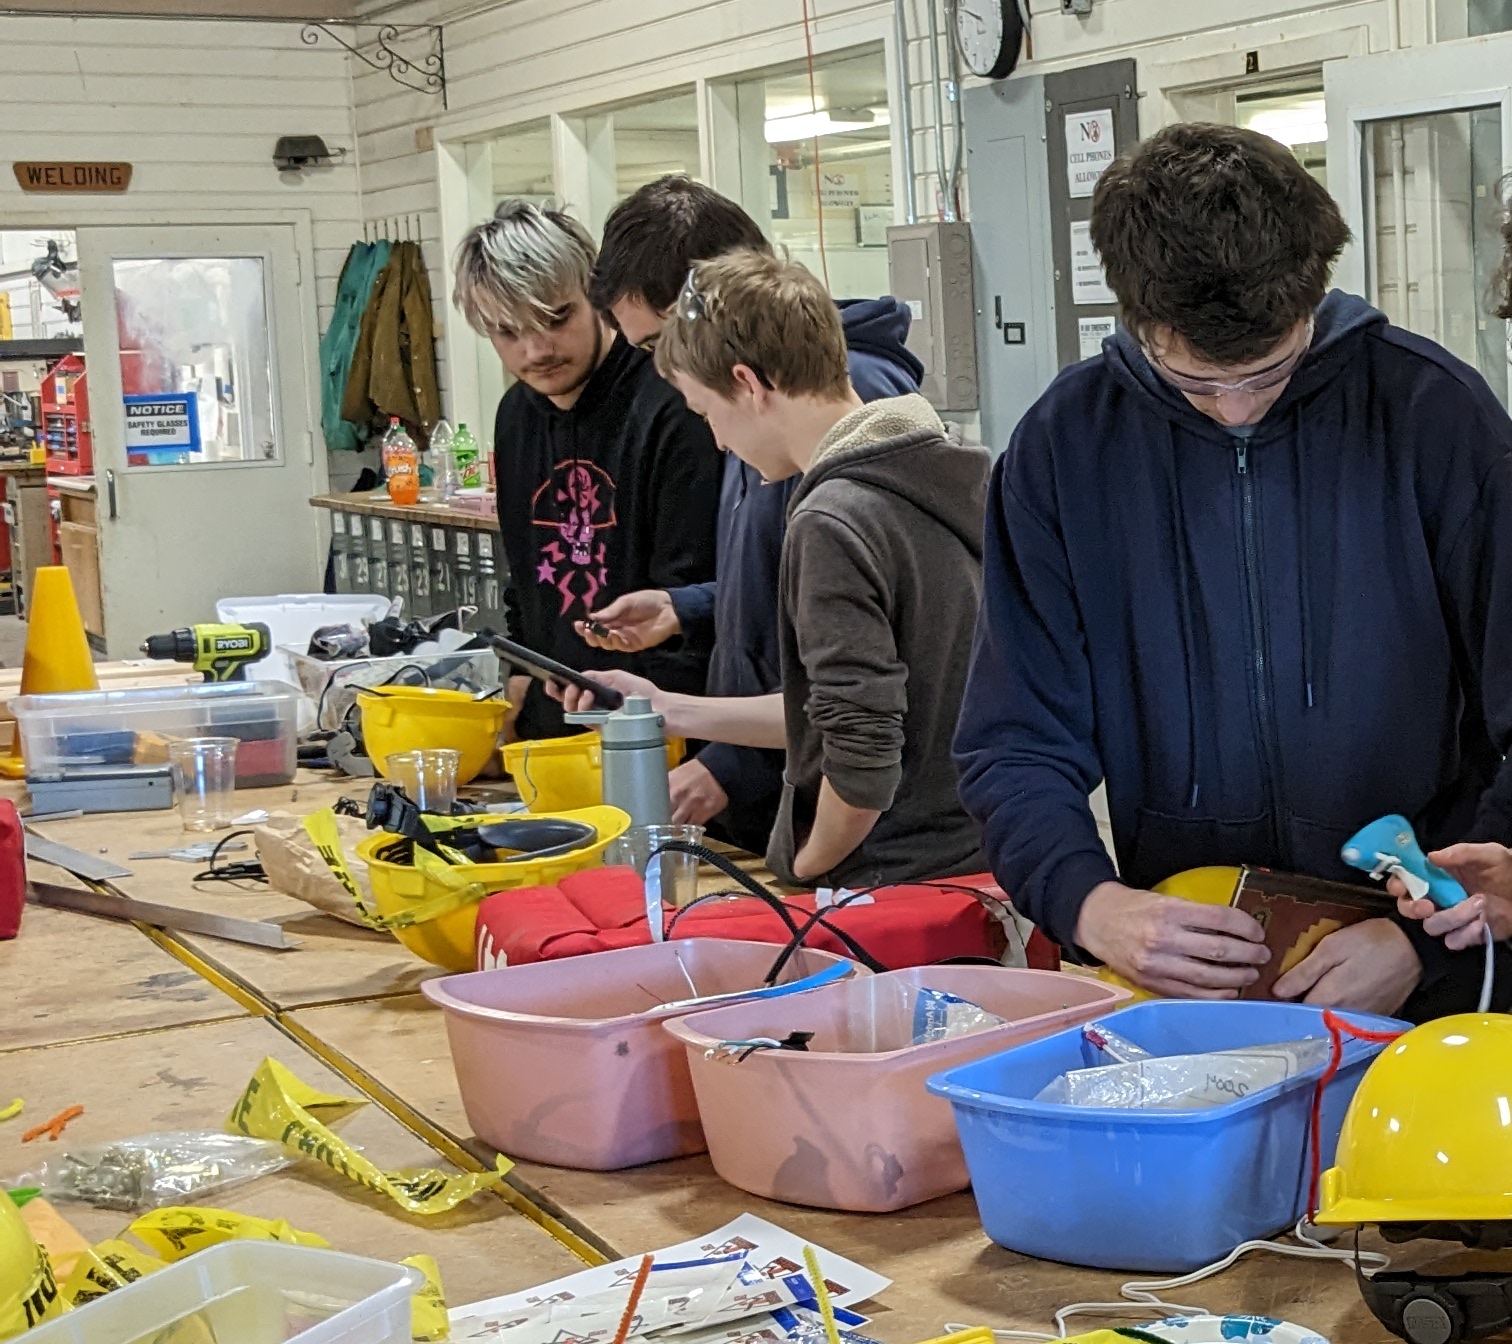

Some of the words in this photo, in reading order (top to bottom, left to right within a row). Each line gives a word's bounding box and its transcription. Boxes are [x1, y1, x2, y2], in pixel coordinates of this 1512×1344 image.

[27, 165, 122, 186] WELDING
[130, 404, 185, 415] NOTICE
[157, 419, 188, 428] GLASSES
[216, 639, 249, 650] RYOBI
